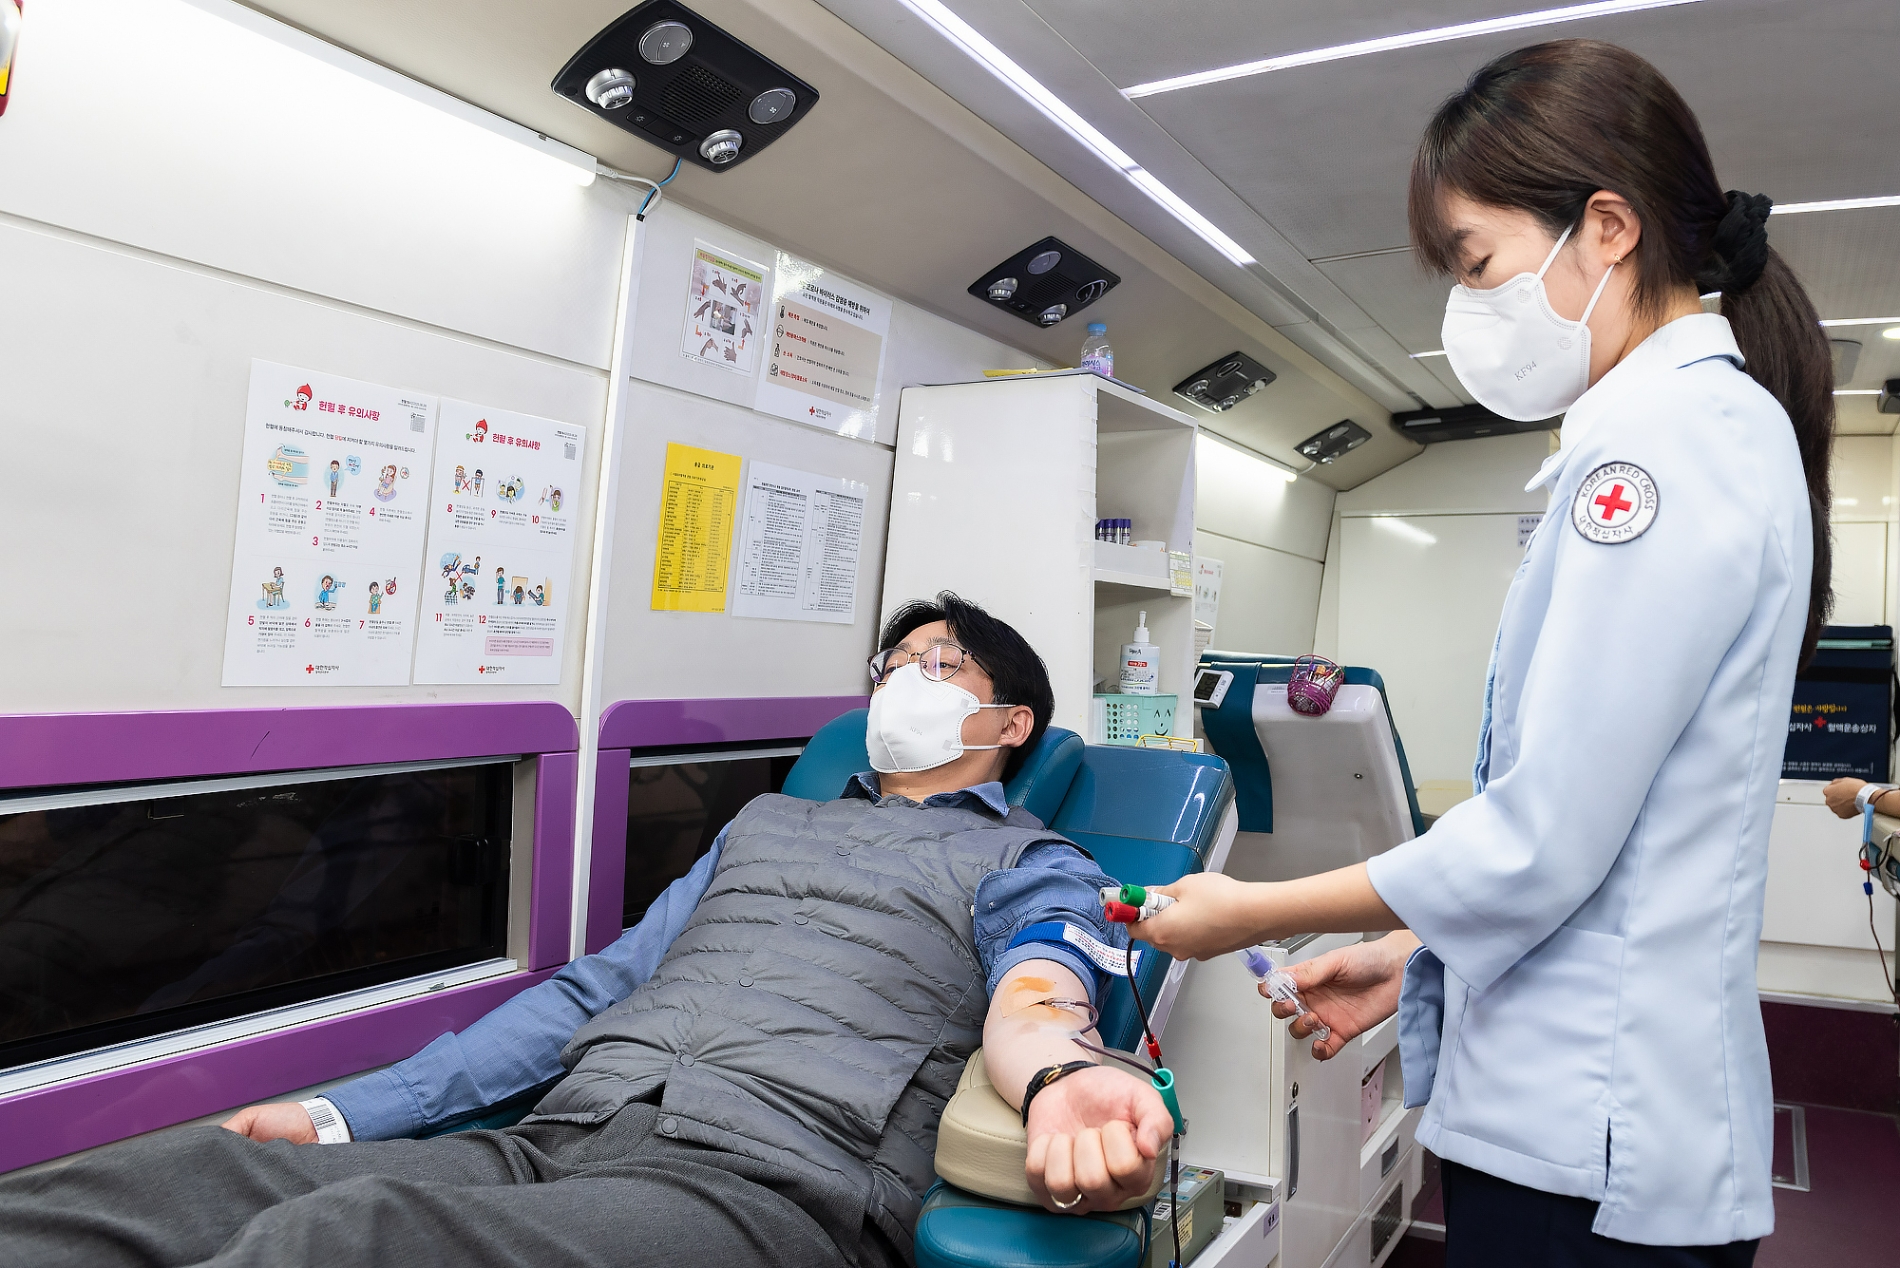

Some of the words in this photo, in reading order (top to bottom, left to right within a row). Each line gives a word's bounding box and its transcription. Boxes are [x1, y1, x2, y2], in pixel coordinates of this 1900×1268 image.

[820, 288, 835, 300] 바이러스
[1514, 361, 1537, 381] KF94
[319, 400, 336, 412] 헌혈
[338, 404, 346, 415] 후
[348, 406, 380, 421] 유의사항
[493, 433, 506, 444] 헌혈
[507, 436, 514, 445] 후
[515, 438, 541, 450] 유의사항
[1581, 466, 1616, 497] KOREAN
[1619, 466, 1640, 479] RED
[1640, 478, 1655, 510] CROSS
[260, 494, 265, 503] 1
[316, 500, 322, 510] 2
[447, 504, 453, 513] 8
[369, 507, 376, 517] 4
[491, 510, 497, 518] 9
[532, 515, 540, 524] 10
[1580, 516, 1633, 539] 대한적십자사
[312, 536, 319, 546] 3
[248, 616, 255, 626] 5
[435, 613, 442, 622] 11
[479, 615, 486, 624] 12
[304, 618, 311, 628] 6
[359, 620, 364, 629] 7
